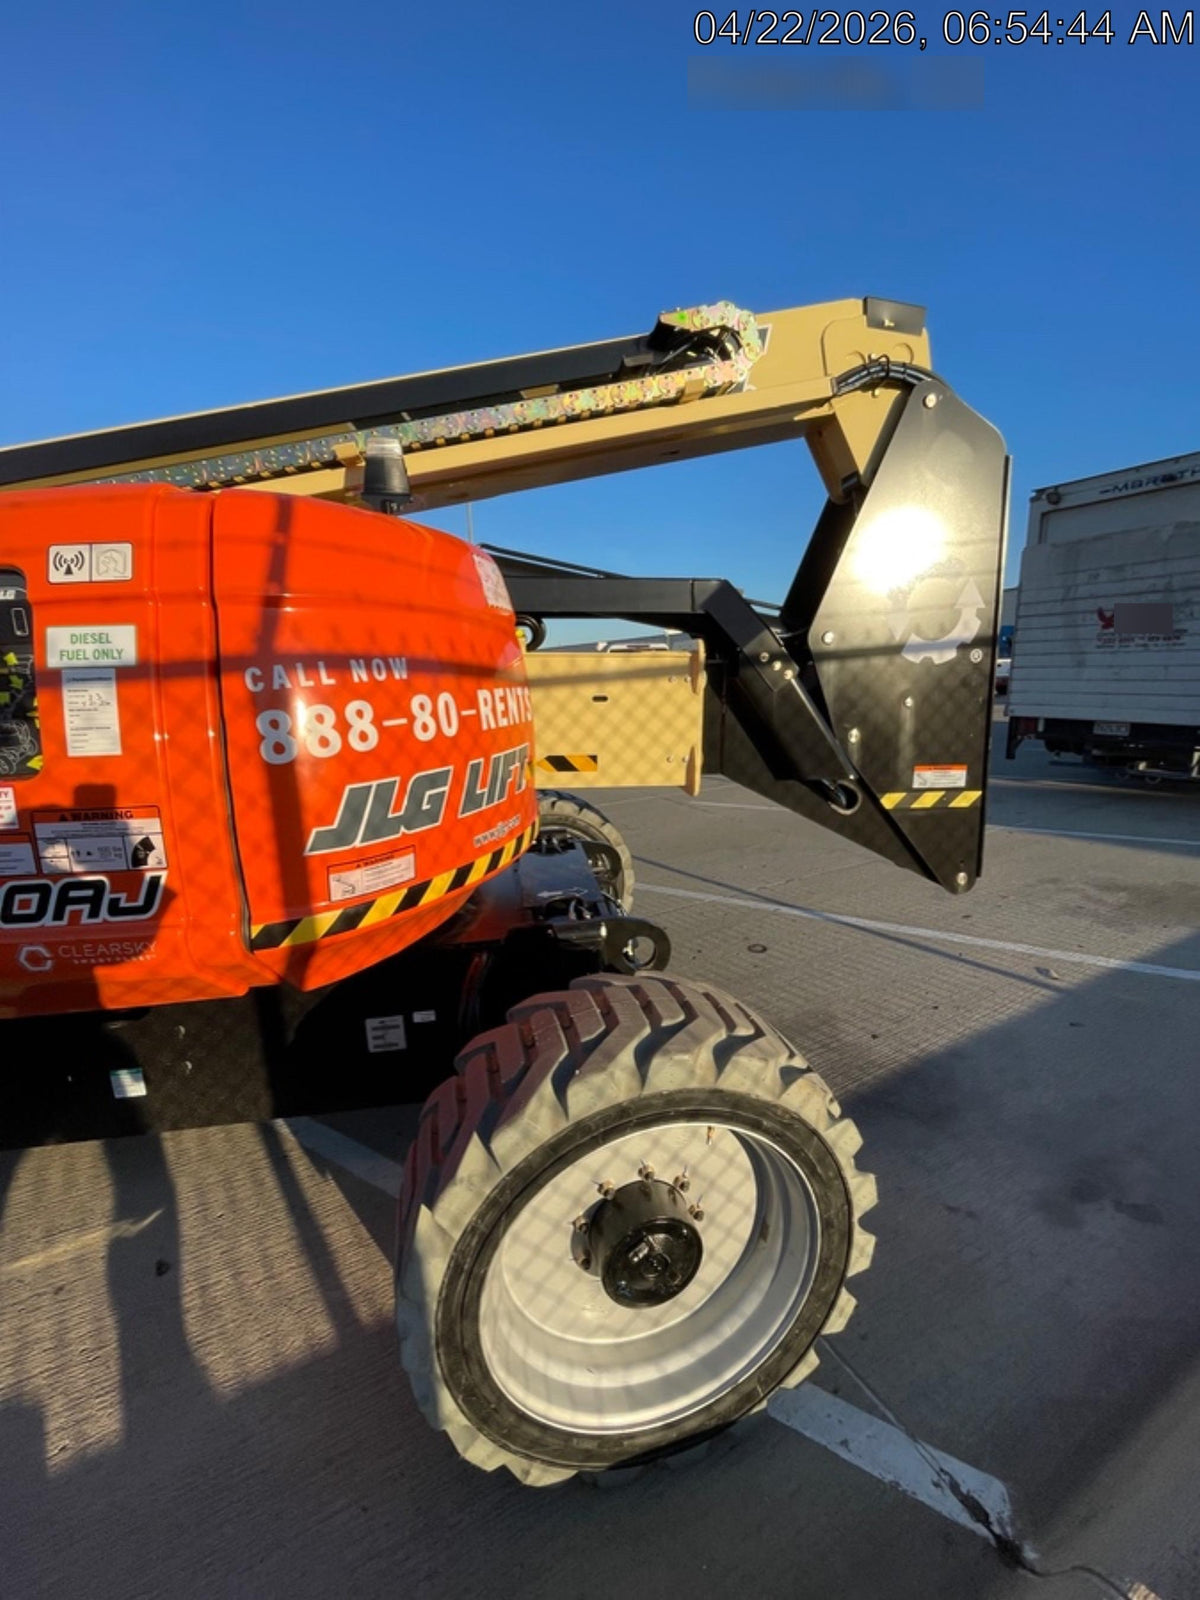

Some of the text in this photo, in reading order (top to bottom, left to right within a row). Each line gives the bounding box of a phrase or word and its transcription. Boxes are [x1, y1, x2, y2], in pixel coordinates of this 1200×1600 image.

[70, 632, 112, 645] DIESEL
[59, 648, 124, 661] FUEL ONLY
[244, 657, 409, 692] CALL NOW
[303, 742, 530, 856] JLG LIFT
[70, 810, 134, 822] WARNING
[58, 941, 158, 958] CLEARSKY
